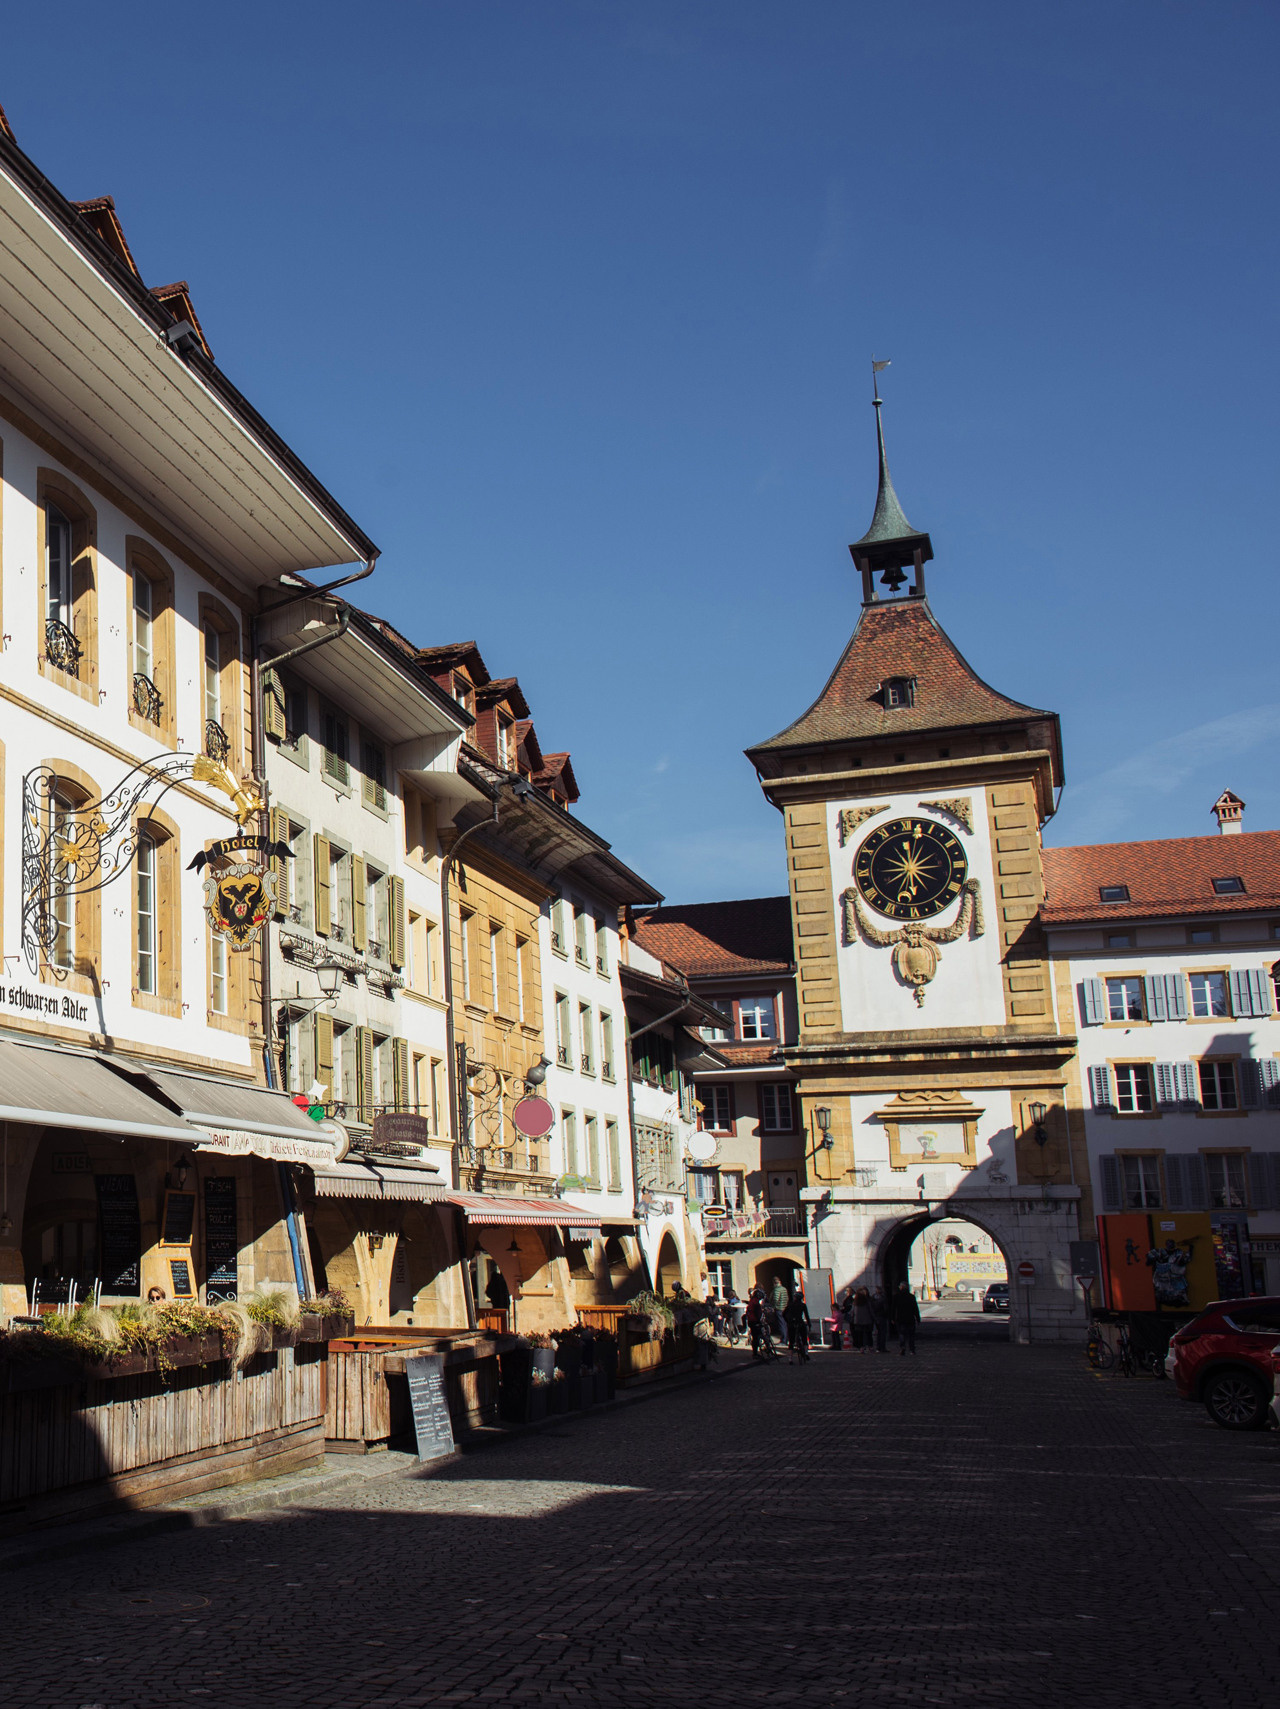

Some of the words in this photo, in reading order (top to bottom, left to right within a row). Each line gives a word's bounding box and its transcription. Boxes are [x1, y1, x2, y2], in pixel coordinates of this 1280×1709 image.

[8, 985, 59, 1017] schwarzen
[61, 995, 89, 1022] Adler
[208, 1133, 231, 1148] URANT
